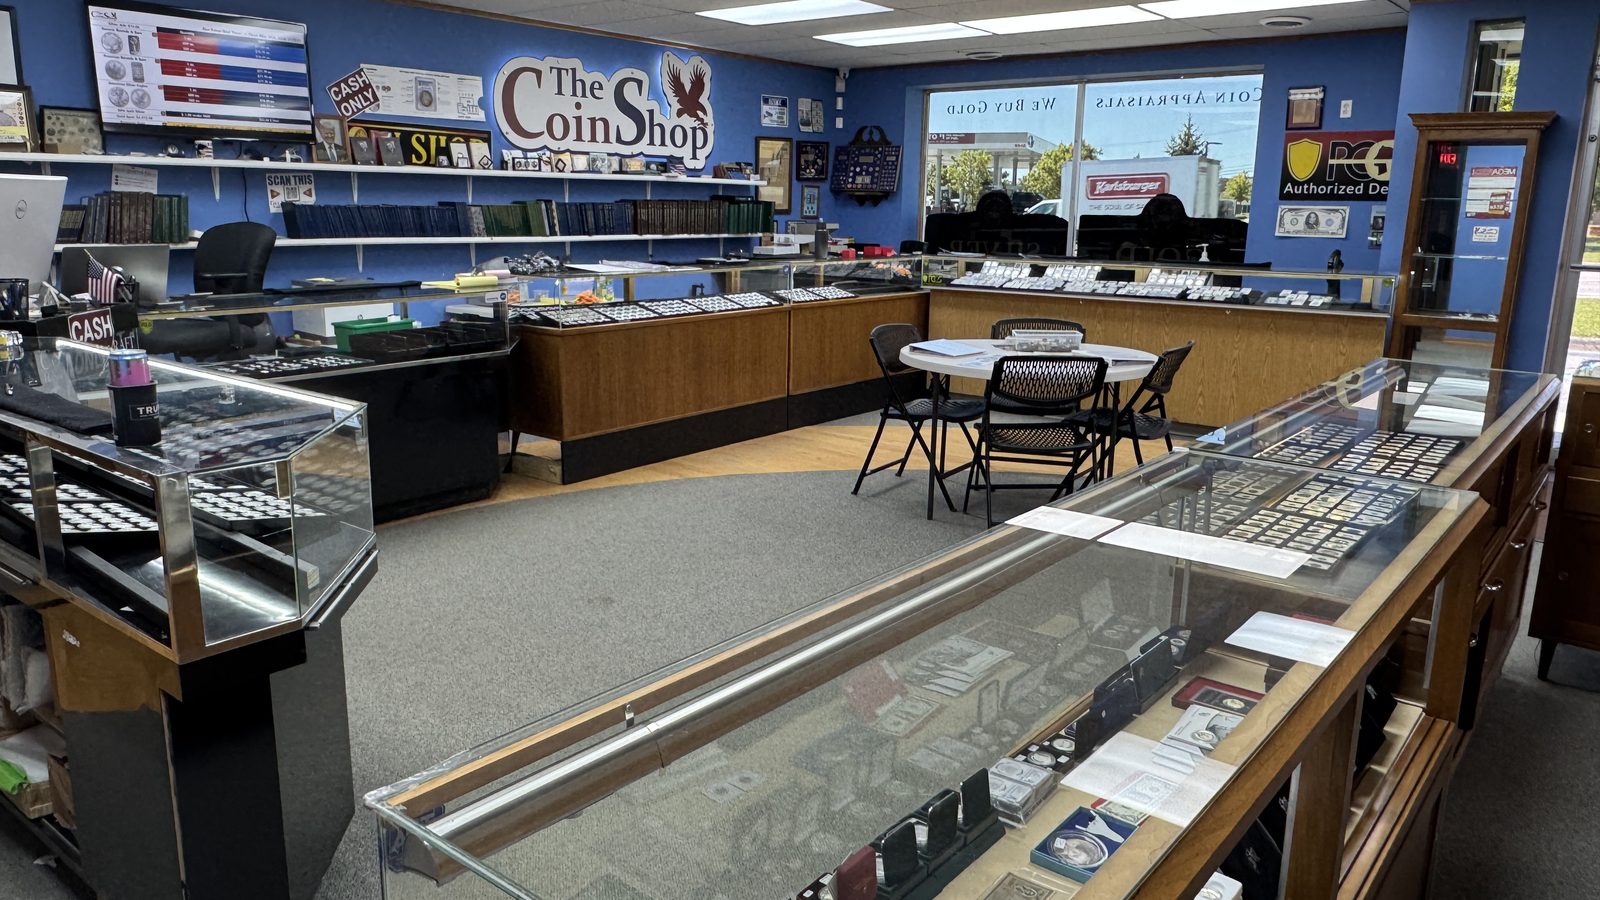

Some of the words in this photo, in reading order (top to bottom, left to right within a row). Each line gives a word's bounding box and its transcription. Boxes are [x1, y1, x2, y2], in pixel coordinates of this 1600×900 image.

[330, 71, 370, 101] CASH
[550, 66, 604, 100] The
[340, 88, 375, 117] ONLY
[502, 66, 613, 144] Coin
[613, 77, 709, 161] Shop
[1326, 139, 1394, 182] PCG
[267, 174, 291, 186] SCAN
[292, 174, 313, 186] THIS
[1283, 182, 1364, 195] Authorized
[1368, 183, 1389, 195] De
[71, 315, 113, 342] CASH
[136, 404, 159, 415] TRU
